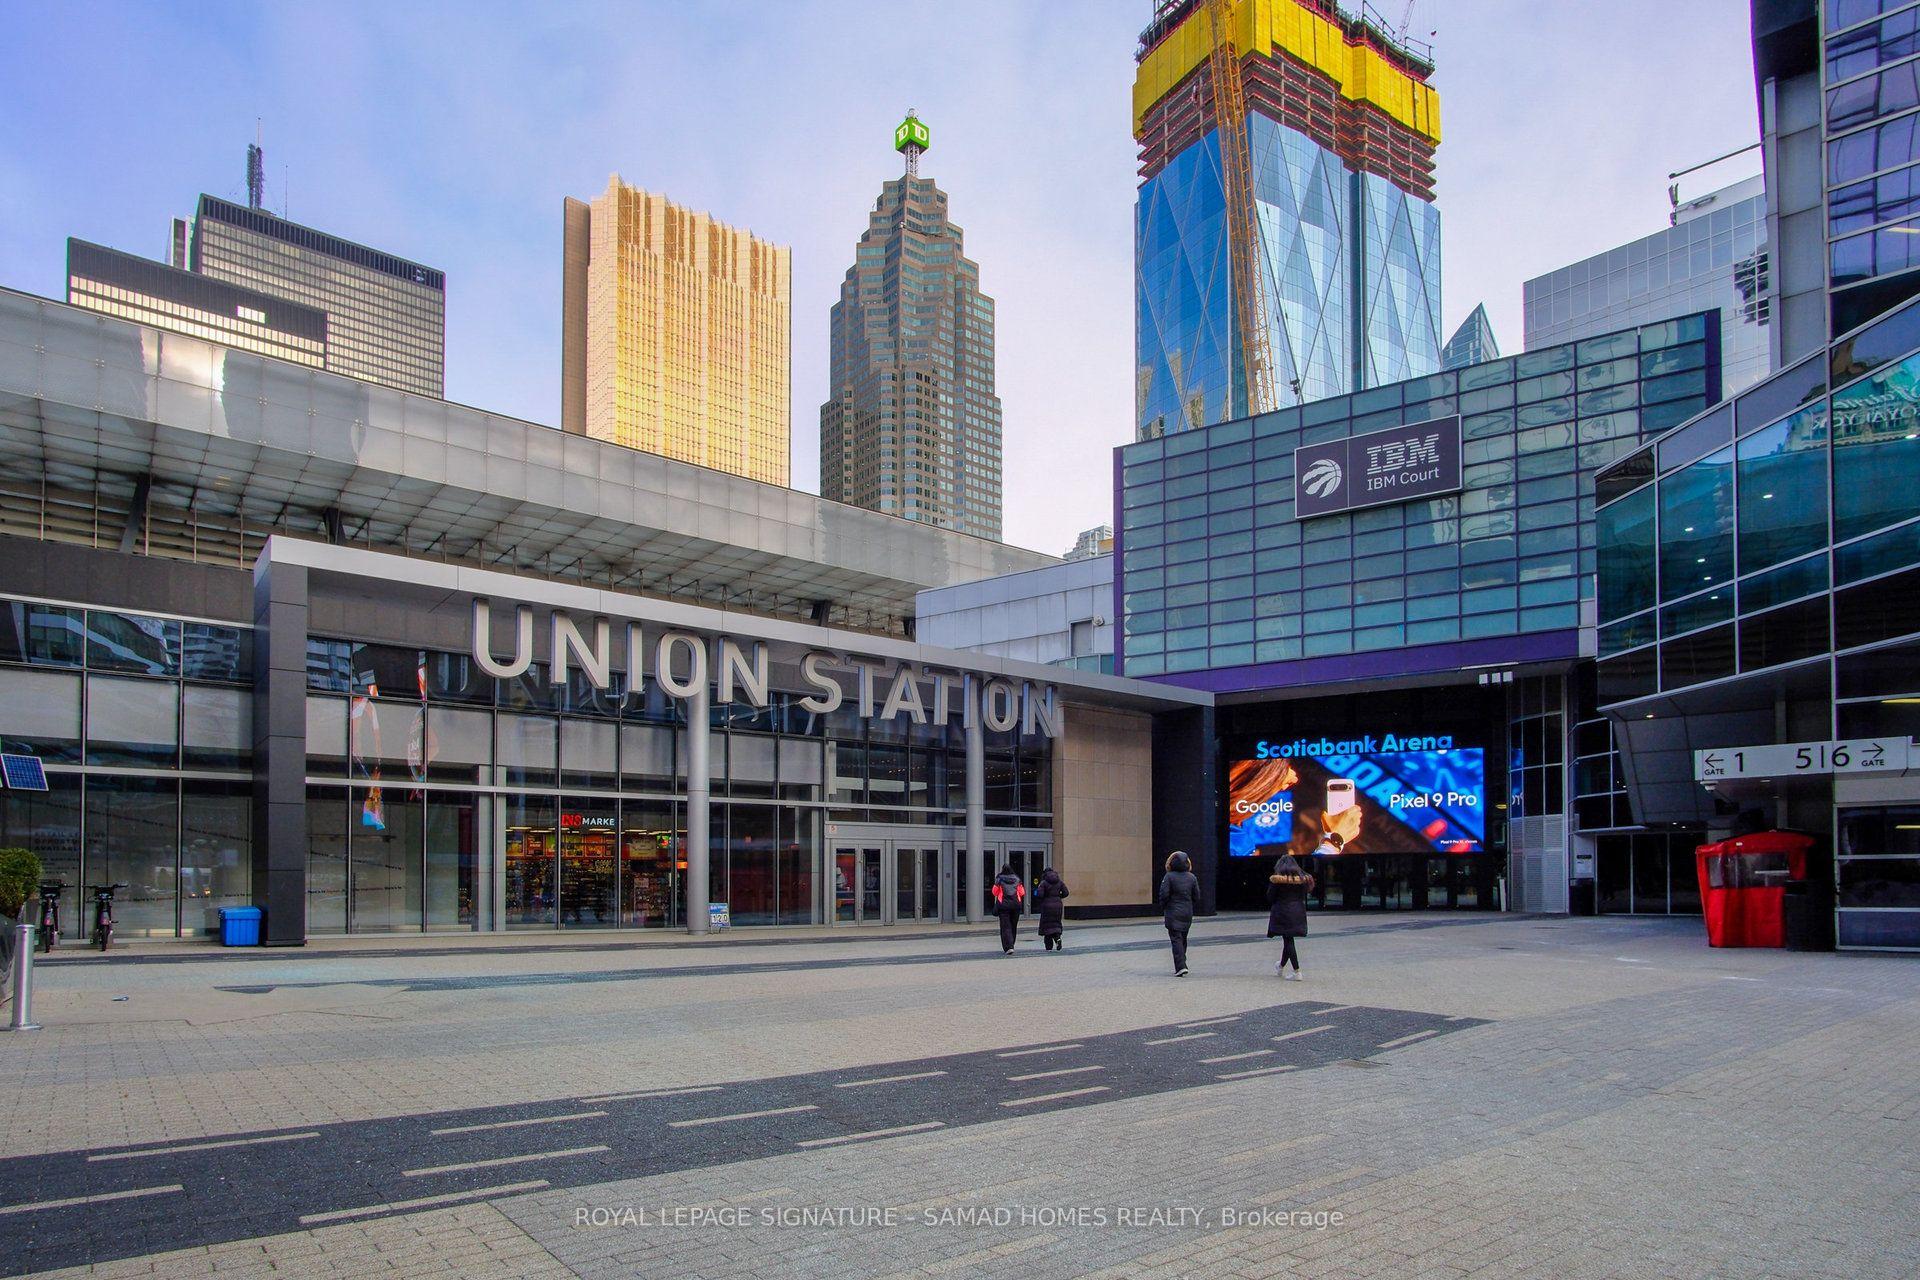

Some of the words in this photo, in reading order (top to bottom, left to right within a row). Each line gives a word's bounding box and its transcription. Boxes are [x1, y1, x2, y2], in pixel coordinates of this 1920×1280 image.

[912, 122, 927, 141] TD
[1367, 433, 1440, 475] IBM
[1367, 474, 1396, 491] IBM
[1400, 467, 1440, 484] Court
[472, 598, 768, 707] UNION
[800, 649, 1058, 738] STATION
[1256, 735, 1377, 759] Scotiabank
[1381, 734, 1452, 752] Arena
[1704, 768, 1725, 776] GATE
[1735, 752, 1744, 772] 1
[1862, 759, 1885, 767] GATE
[1236, 799, 1293, 815] Google
[1390, 793, 1428, 808] Pixel
[1433, 793, 1443, 807] 9
[1447, 792, 1477, 806] Pro
[582, 817, 622, 826] MARKE
